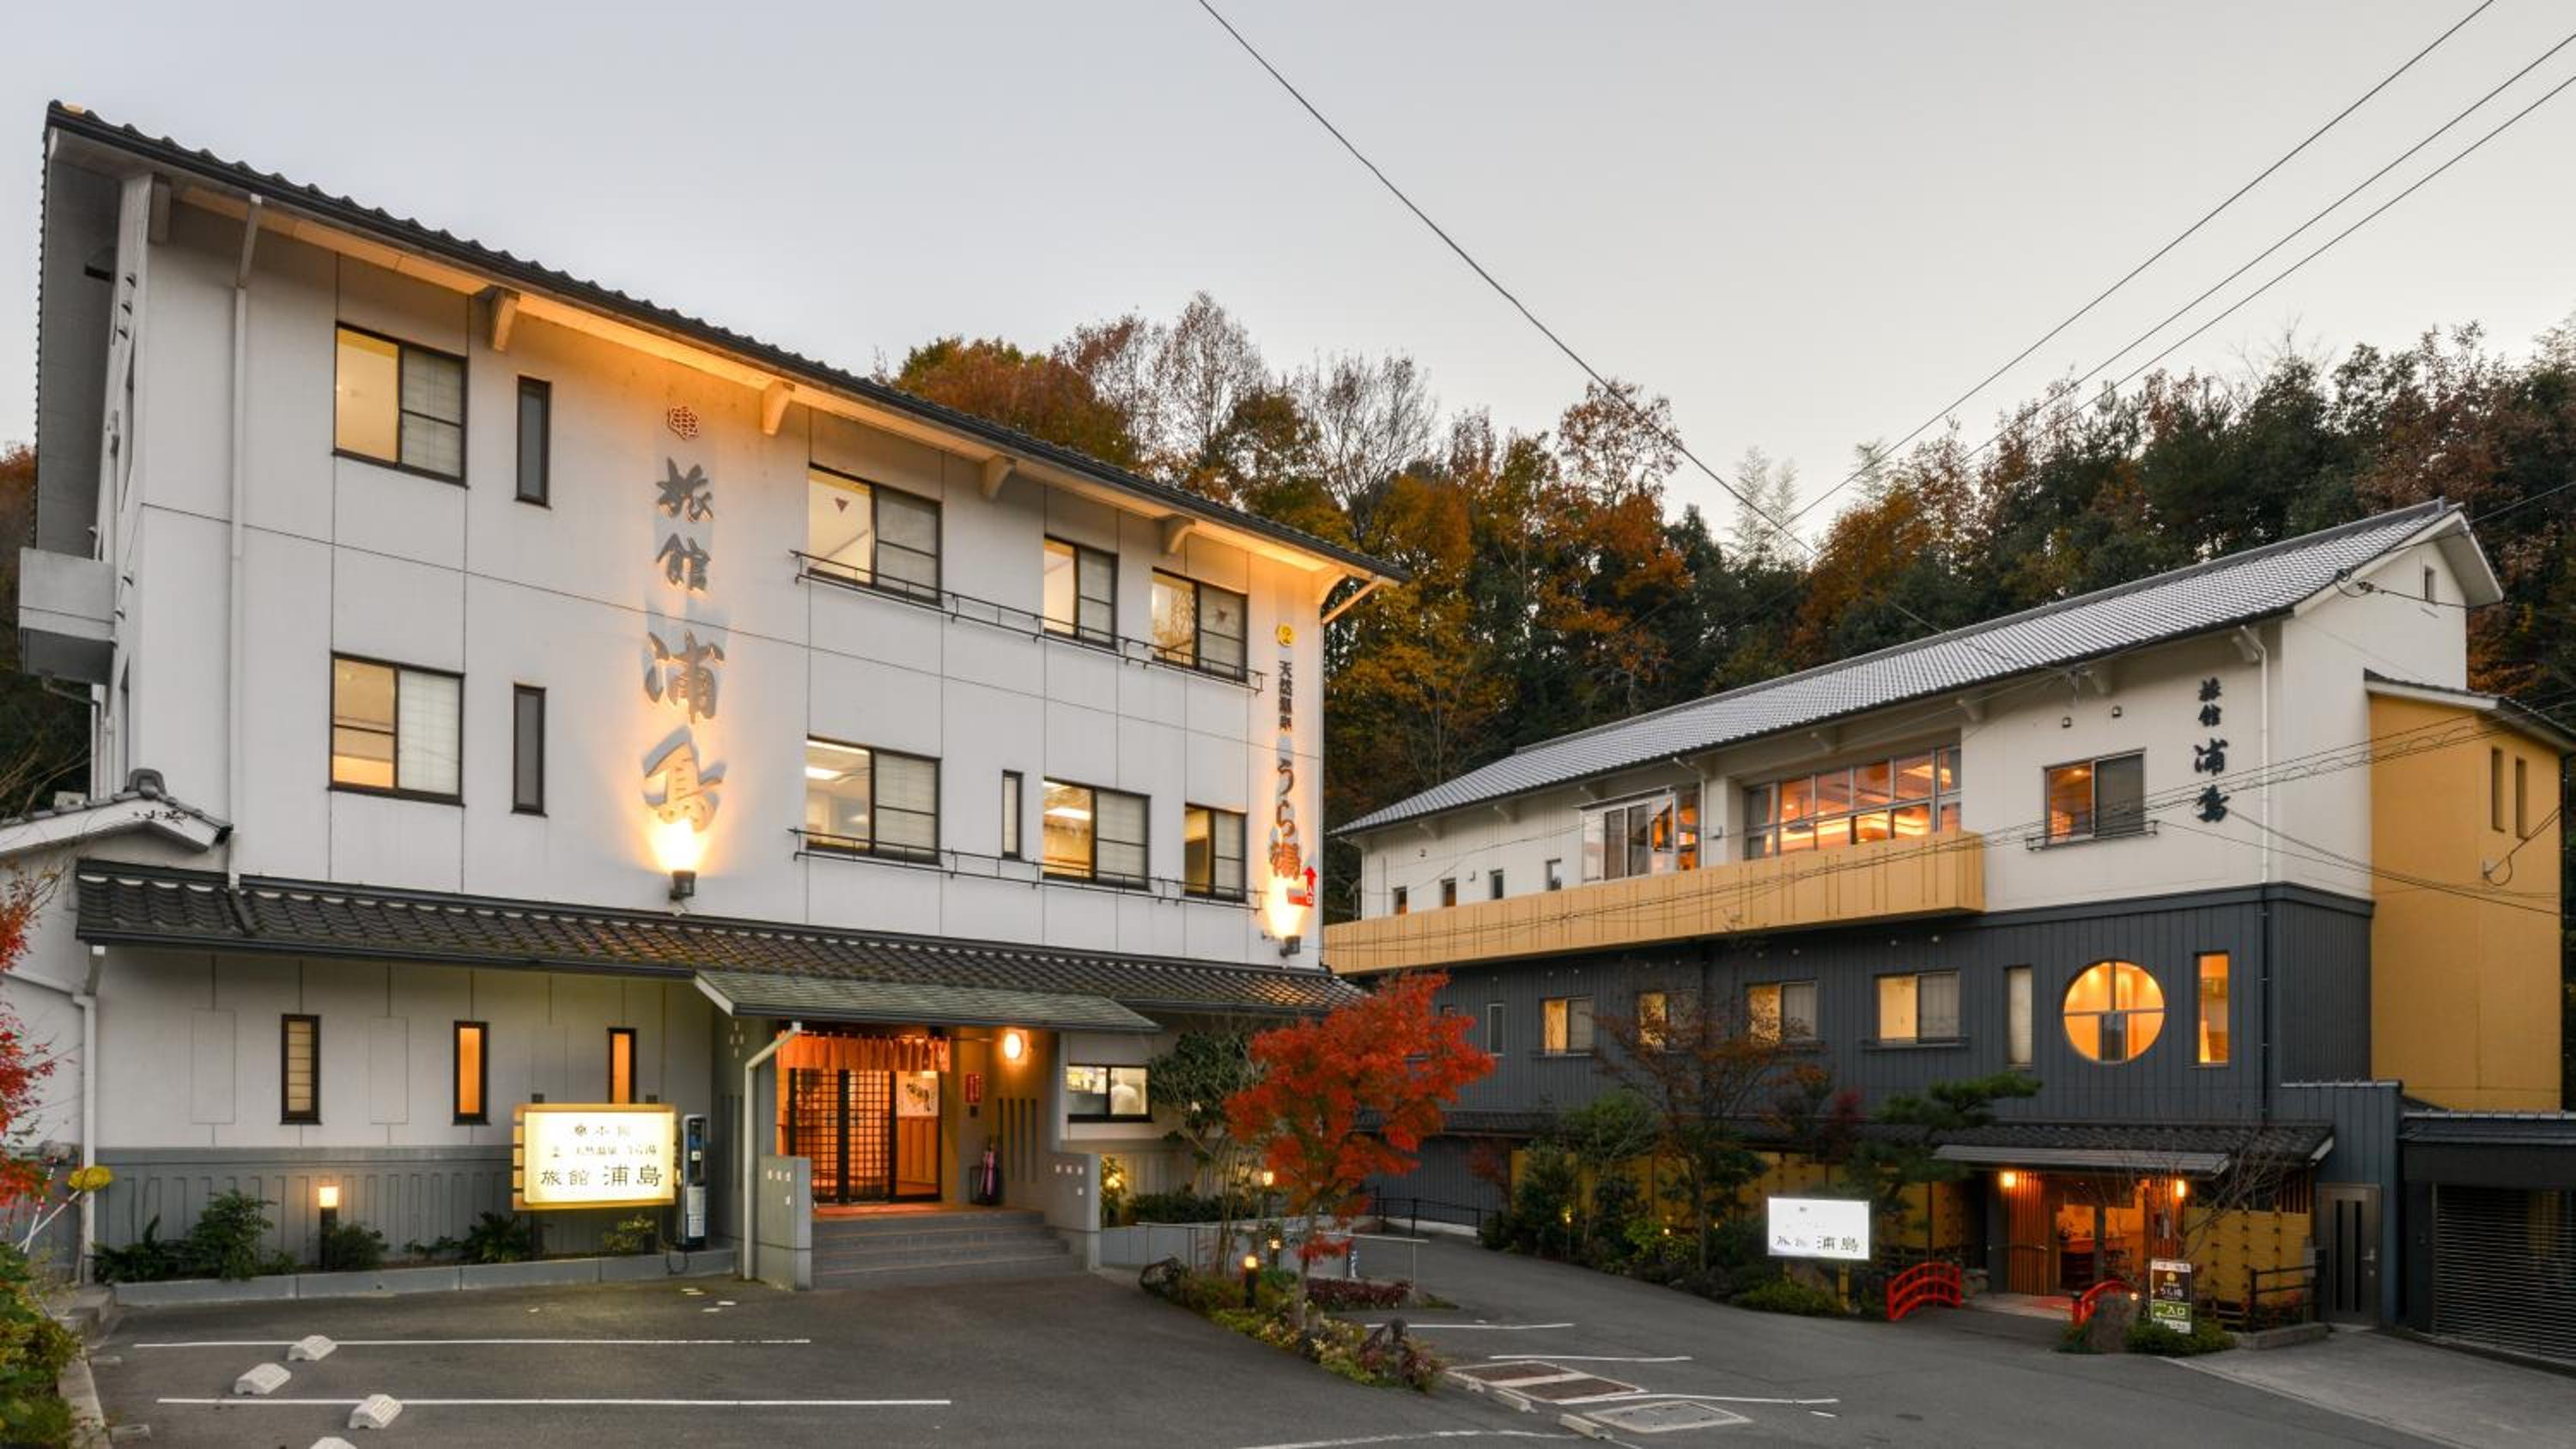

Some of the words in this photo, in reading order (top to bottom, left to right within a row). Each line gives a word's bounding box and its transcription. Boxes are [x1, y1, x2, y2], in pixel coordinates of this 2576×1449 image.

[644, 457, 726, 833] 旅館浦島
[2194, 676, 2229, 822] 旅館浦島
[540, 1164, 663, 1188] 旅館浦島
